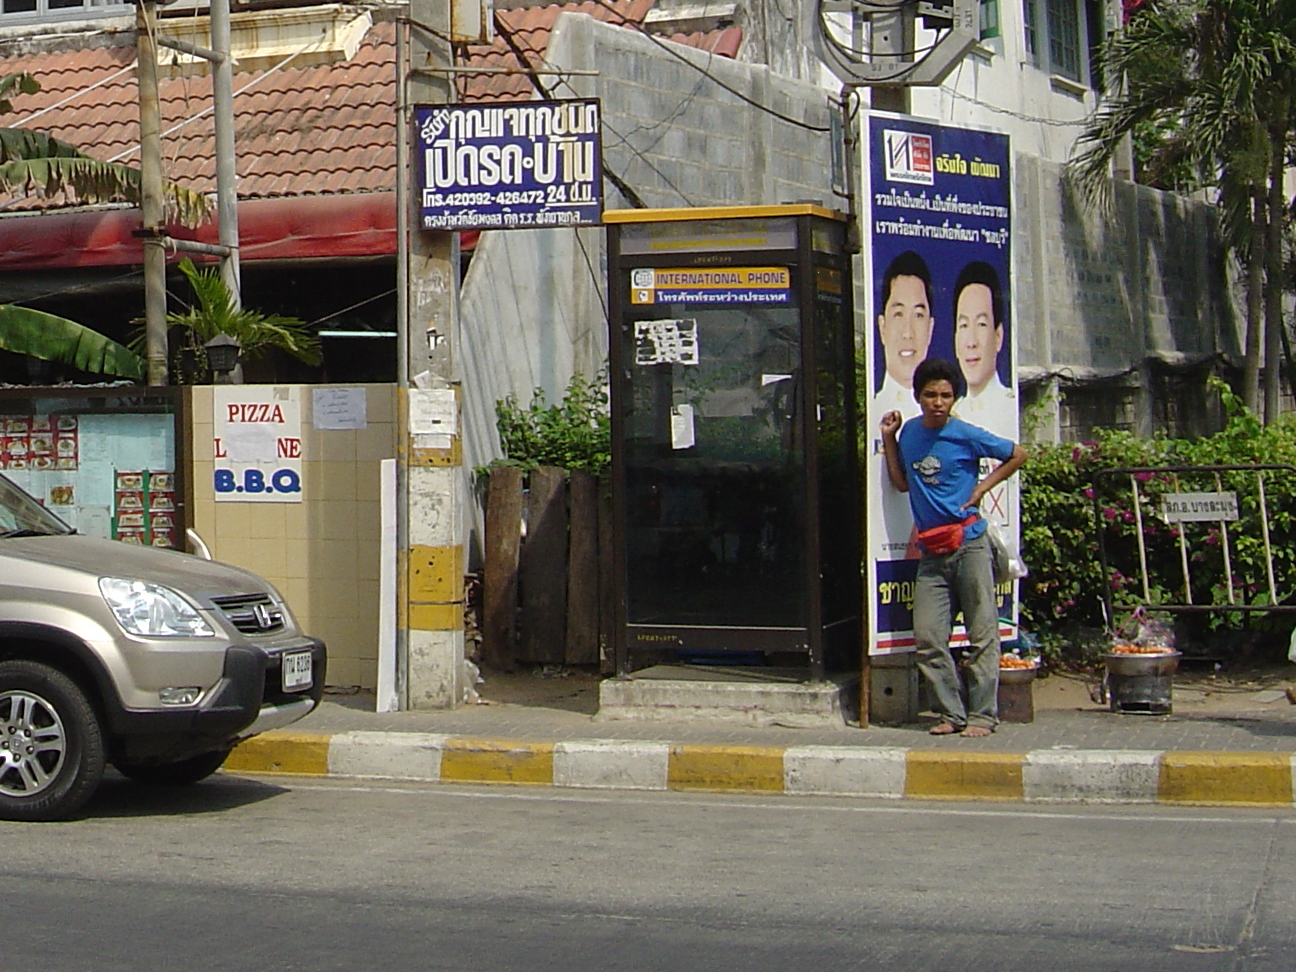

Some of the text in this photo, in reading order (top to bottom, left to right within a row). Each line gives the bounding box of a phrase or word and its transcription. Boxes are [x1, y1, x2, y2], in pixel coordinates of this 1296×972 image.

[656, 271, 786, 285] INTERNATIONAL PHONE
[657, 290, 787, 303] โทรศัพท์ระหว่างประเทศ
[227, 403, 285, 424] PIZZA
